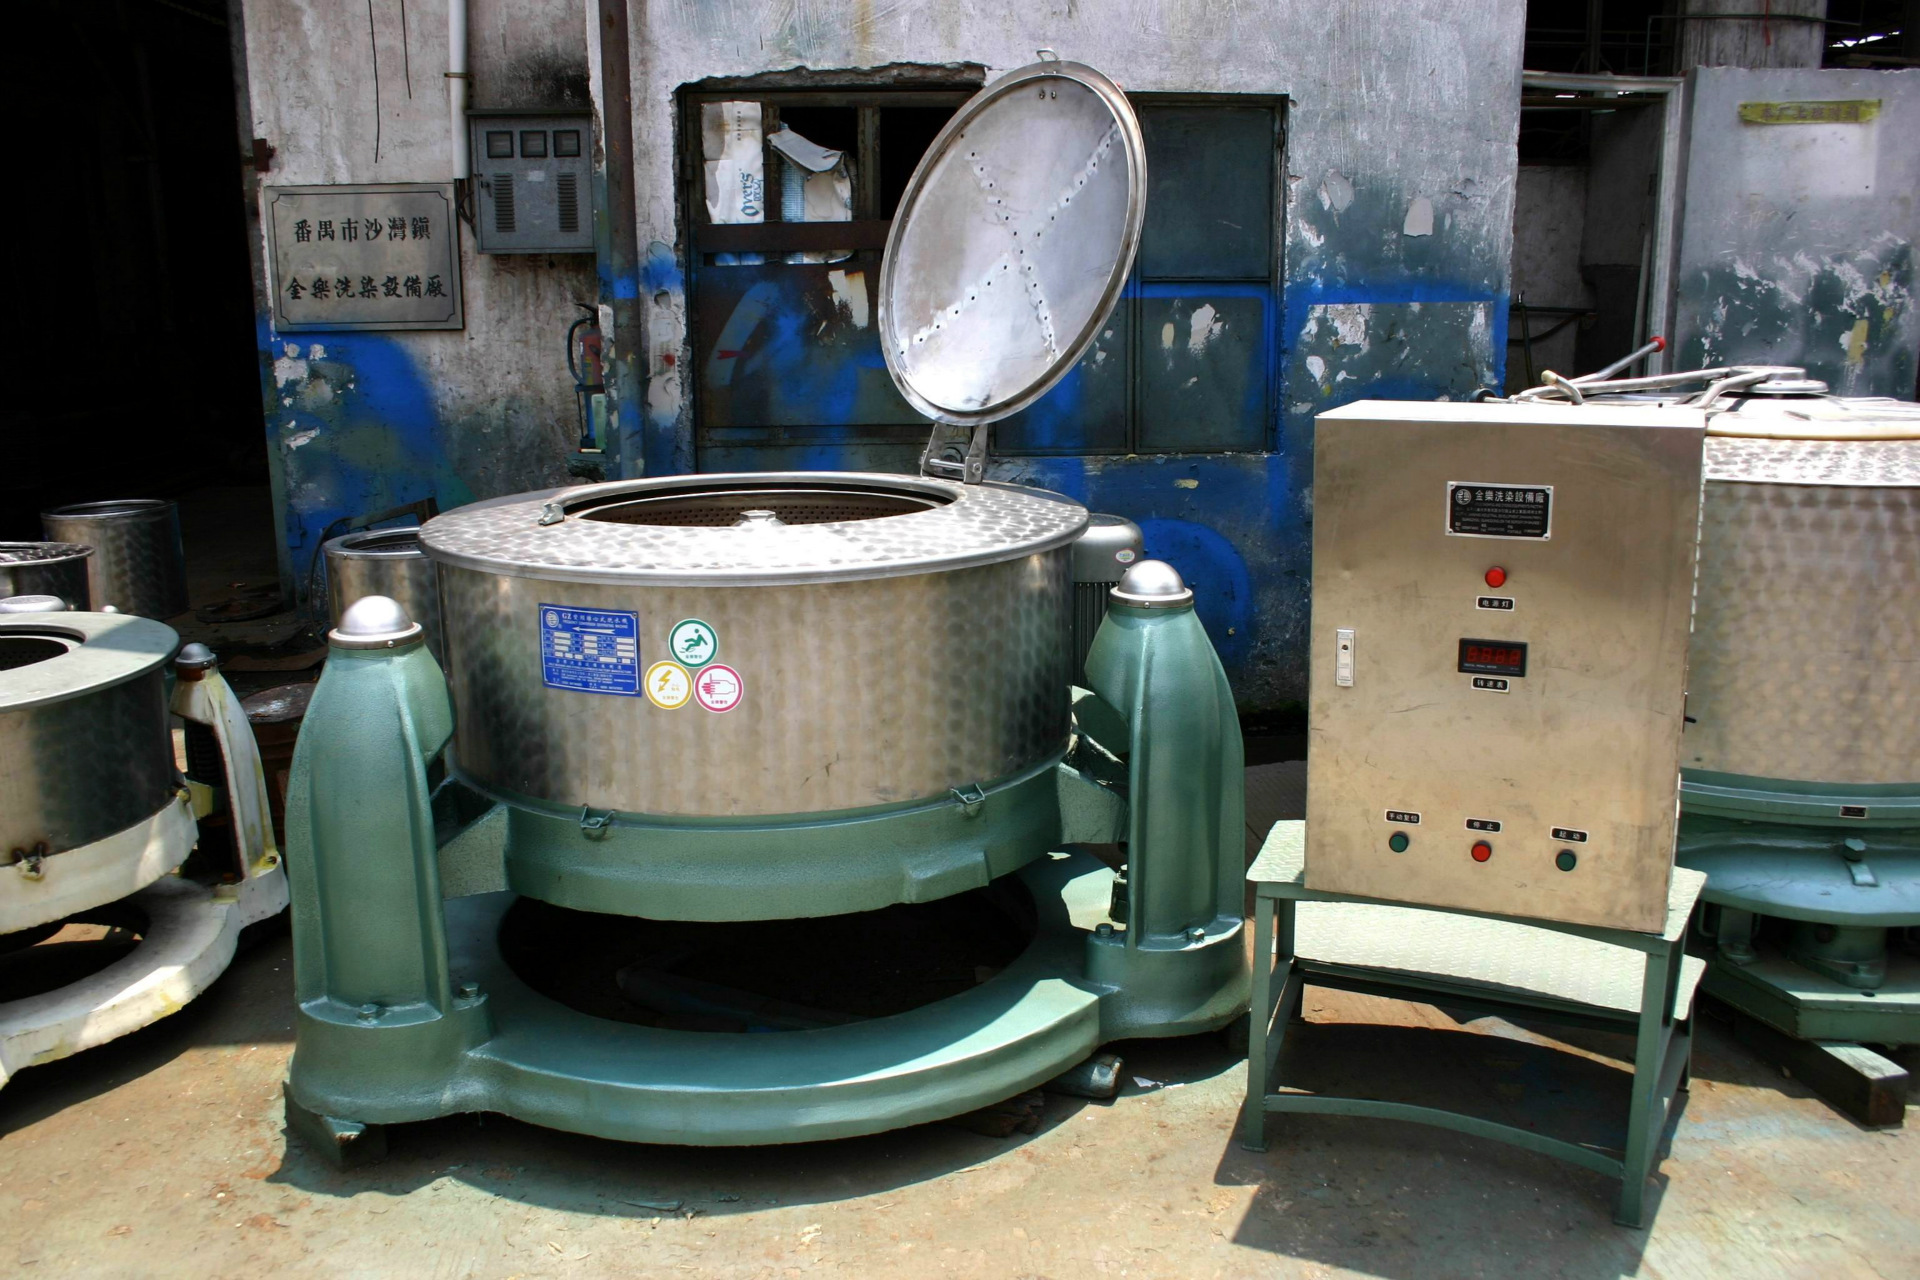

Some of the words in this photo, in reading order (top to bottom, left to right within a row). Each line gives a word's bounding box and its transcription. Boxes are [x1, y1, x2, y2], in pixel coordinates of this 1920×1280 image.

[293, 216, 431, 243] 番禺市沙灣鎮
[1482, 598, 1510, 609] 电源灯
[1473, 821, 1494, 830] 停止
